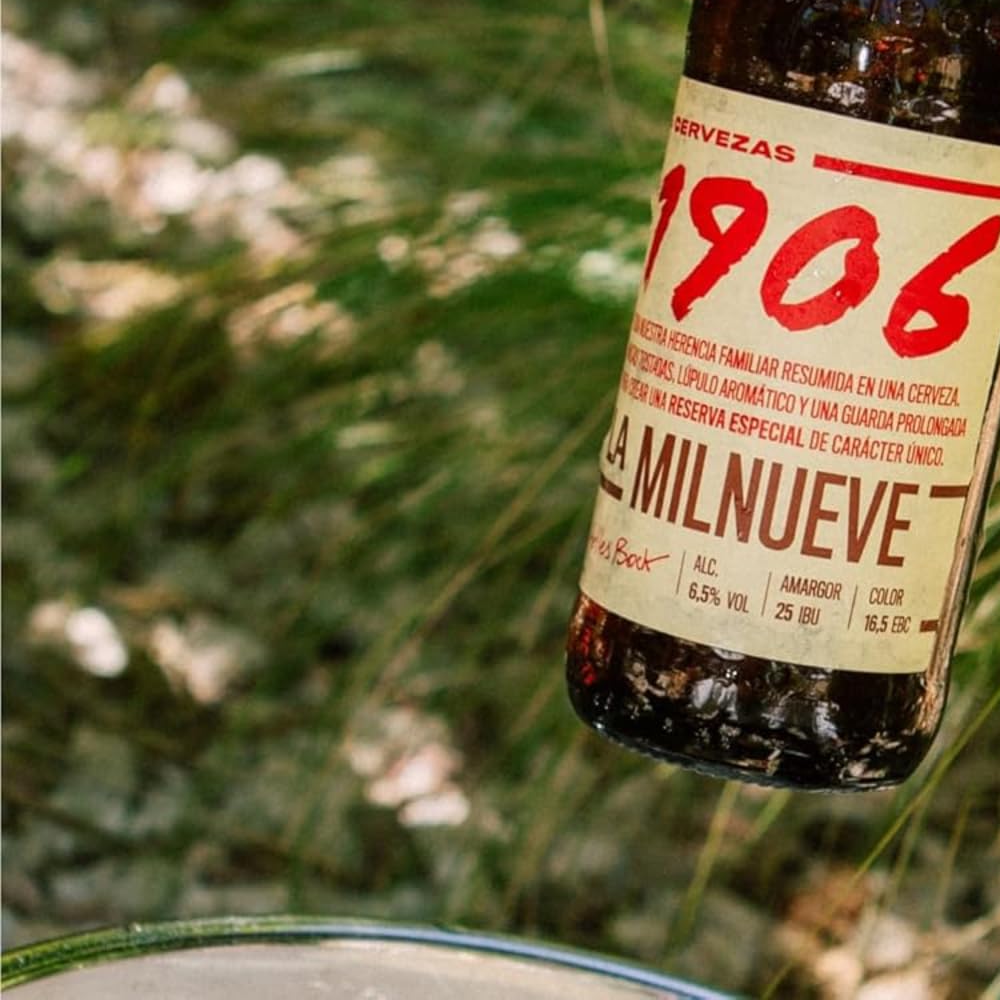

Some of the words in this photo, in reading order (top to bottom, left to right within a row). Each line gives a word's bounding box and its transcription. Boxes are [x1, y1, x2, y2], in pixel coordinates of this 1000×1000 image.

[674, 115, 796, 163] CERVEZAS
[668, 327, 717, 364] HERENCIA
[718, 344, 780, 380] FAMILIAR
[781, 360, 854, 394] RESUMIDA
[856, 375, 877, 398] EN
[878, 379, 906, 401] UNA
[907, 383, 961, 407] CERVEZA.
[677, 362, 720, 396] LÚPULO
[719, 378, 797, 416] AROMÁTICO
[799, 396, 810, 415] Y
[810, 398, 839, 422] UNA
[840, 403, 894, 432] GUARDA
[896, 412, 968, 438] PROLONGADA
[648, 387, 668, 411] UNA
[667, 394, 726, 430] RESERVA
[728, 412, 805, 449] ESPECIAL
[808, 429, 831, 453] DE
[831, 435, 905, 464] CARÁCTER
[905, 441, 945, 467] ÚNICO.
[606, 414, 629, 471] LA
[630, 425, 920, 568] MILNUEVE
[693, 554, 719, 577] ALC.
[688, 581, 721, 607] 6,5%
[727, 590, 750, 614] VOL
[779, 575, 843, 601] AMARGOR
[868, 586, 905, 607] COLOR
[774, 601, 795, 622] 25
[797, 605, 821, 626] IBU
[863, 613, 888, 634] 16,5
[890, 614, 912, 634] EBC
